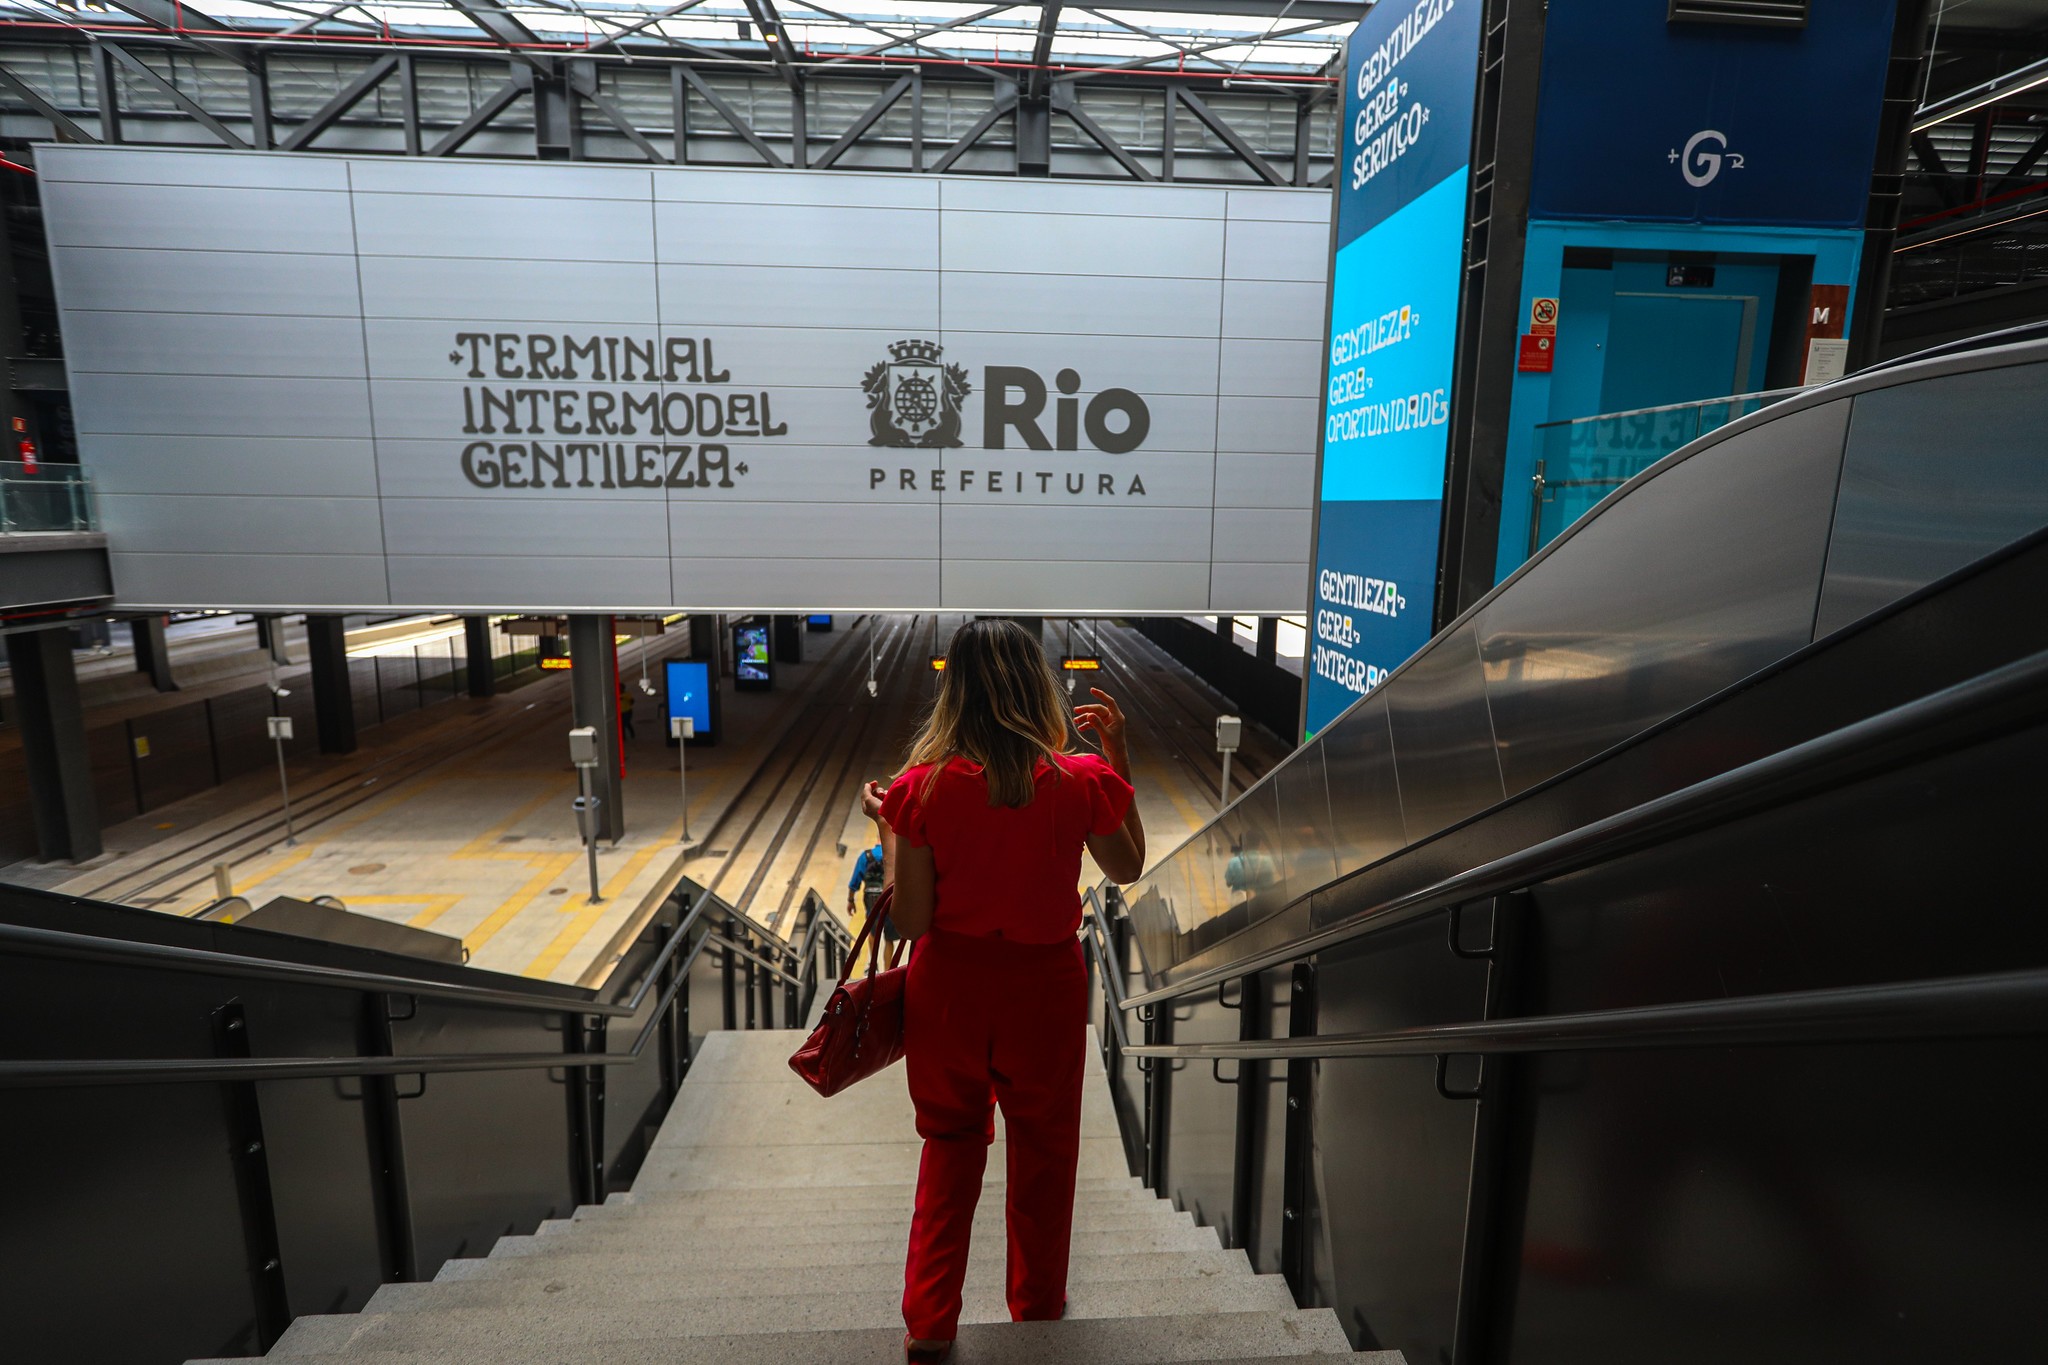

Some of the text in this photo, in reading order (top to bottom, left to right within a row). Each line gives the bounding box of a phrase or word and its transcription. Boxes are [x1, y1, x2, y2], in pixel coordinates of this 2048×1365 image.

[1355, 77, 1399, 146] GERA
[1352, 102, 1422, 190] SERVIÇO
[1332, 304, 1411, 366] GENTILEZA
[1812, 307, 1830, 325] M
[456, 333, 730, 383] TERMINAL
[462, 386, 788, 436] INTERMODAL
[983, 365, 1151, 455] Rio
[1330, 367, 1365, 406] GERA
[460, 441, 735, 489] GENTILEZA
[869, 468, 1147, 496] PREFEITURA
[1319, 569, 1397, 617] GENTILEZA
[1317, 609, 1353, 648] GERA
